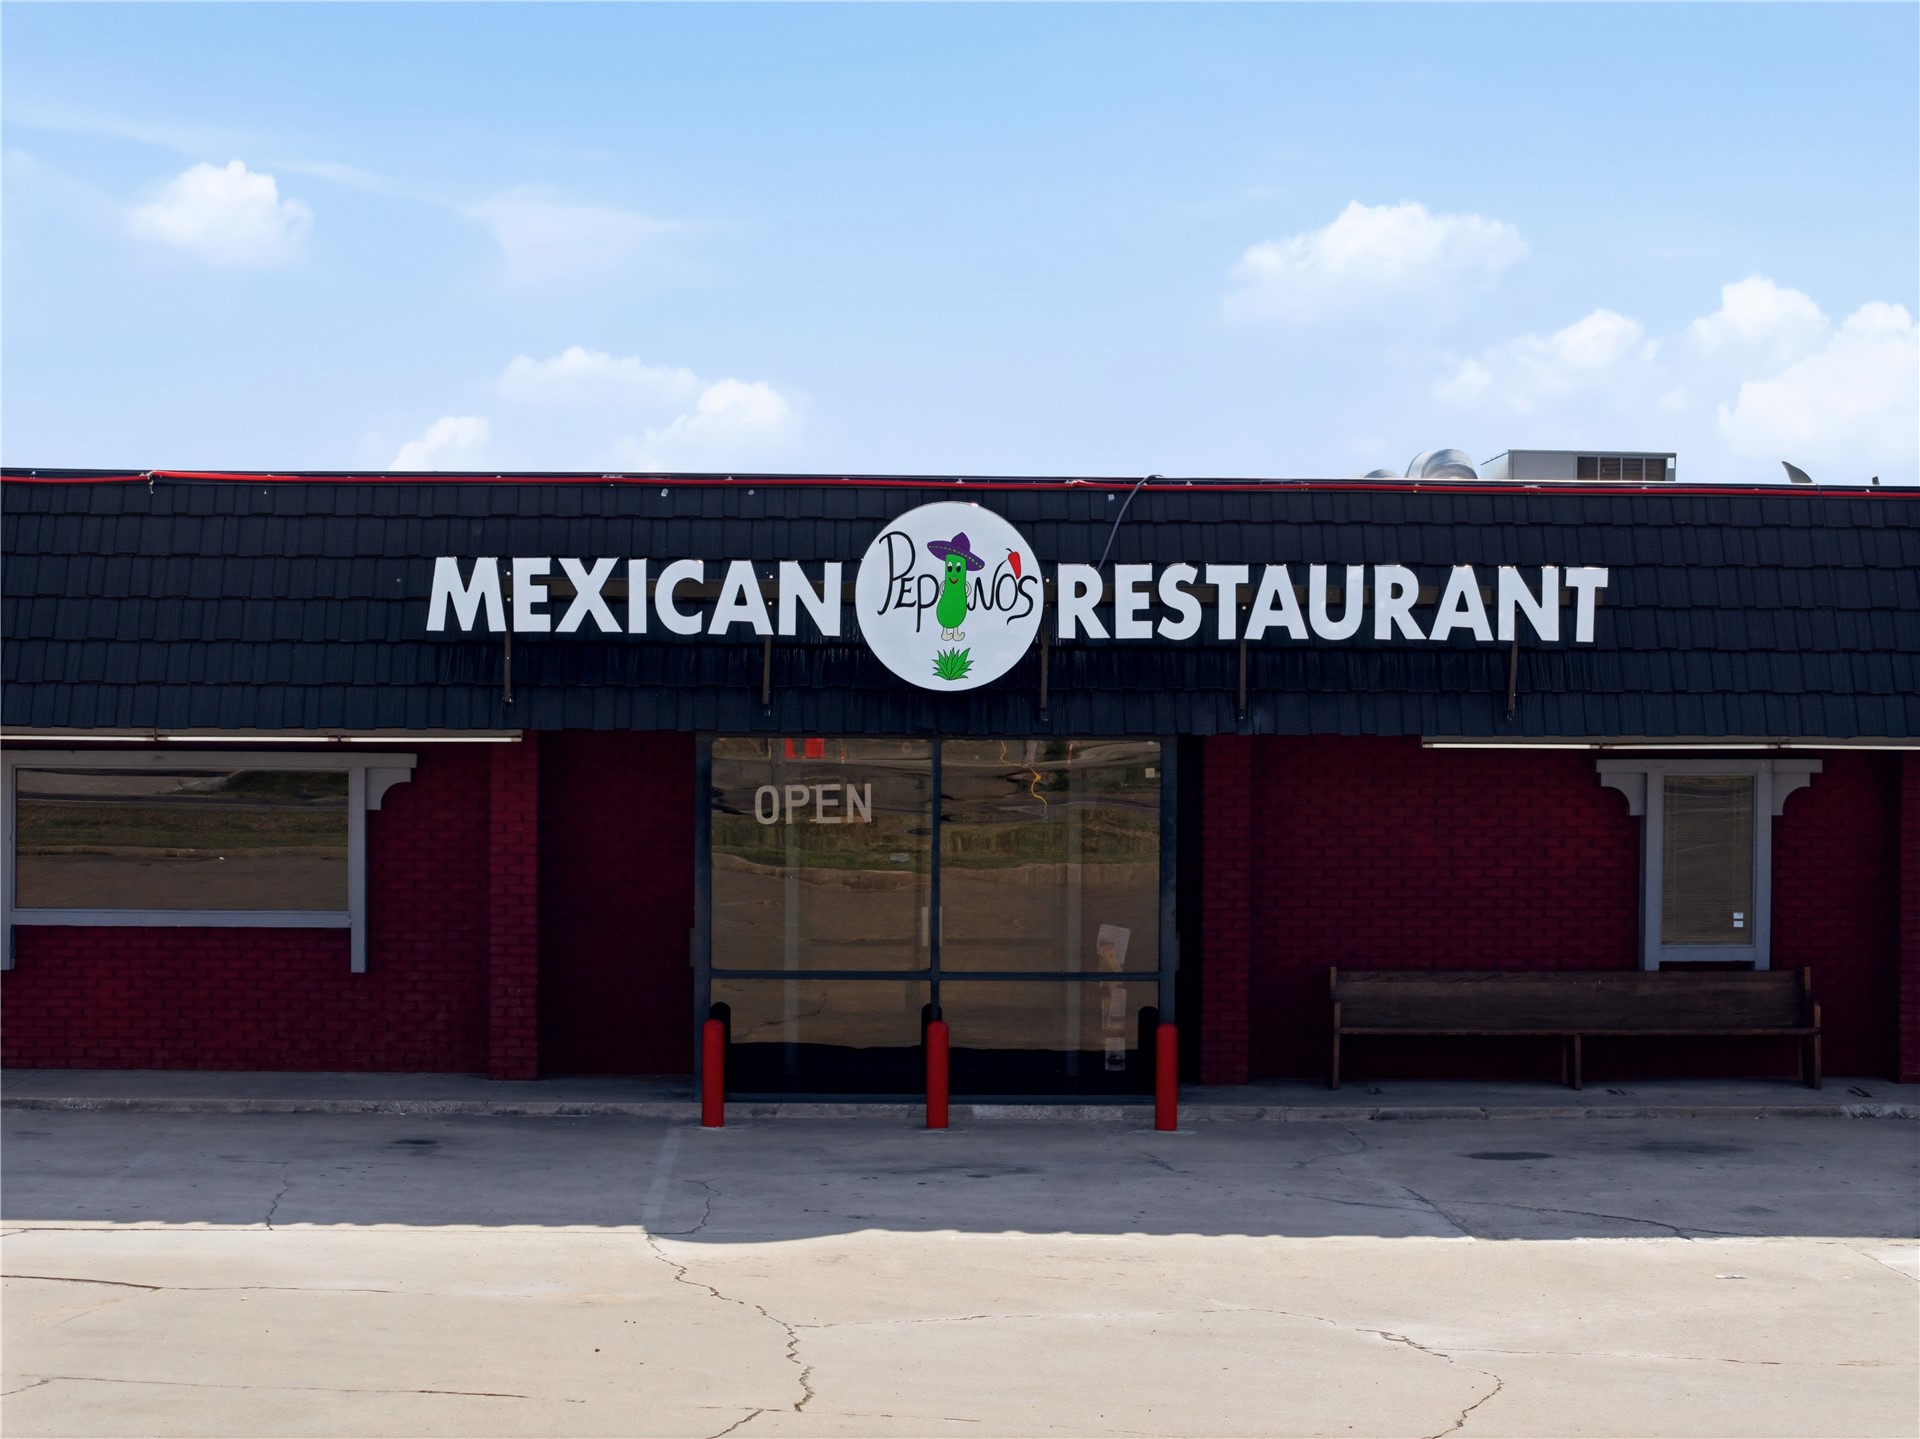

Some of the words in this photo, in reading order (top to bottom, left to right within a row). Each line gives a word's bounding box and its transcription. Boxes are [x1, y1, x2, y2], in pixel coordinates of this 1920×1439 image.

[426, 556, 842, 636] MEXICAN
[1057, 562, 1609, 643] RESTAURANT
[754, 783, 872, 825] OPEN
